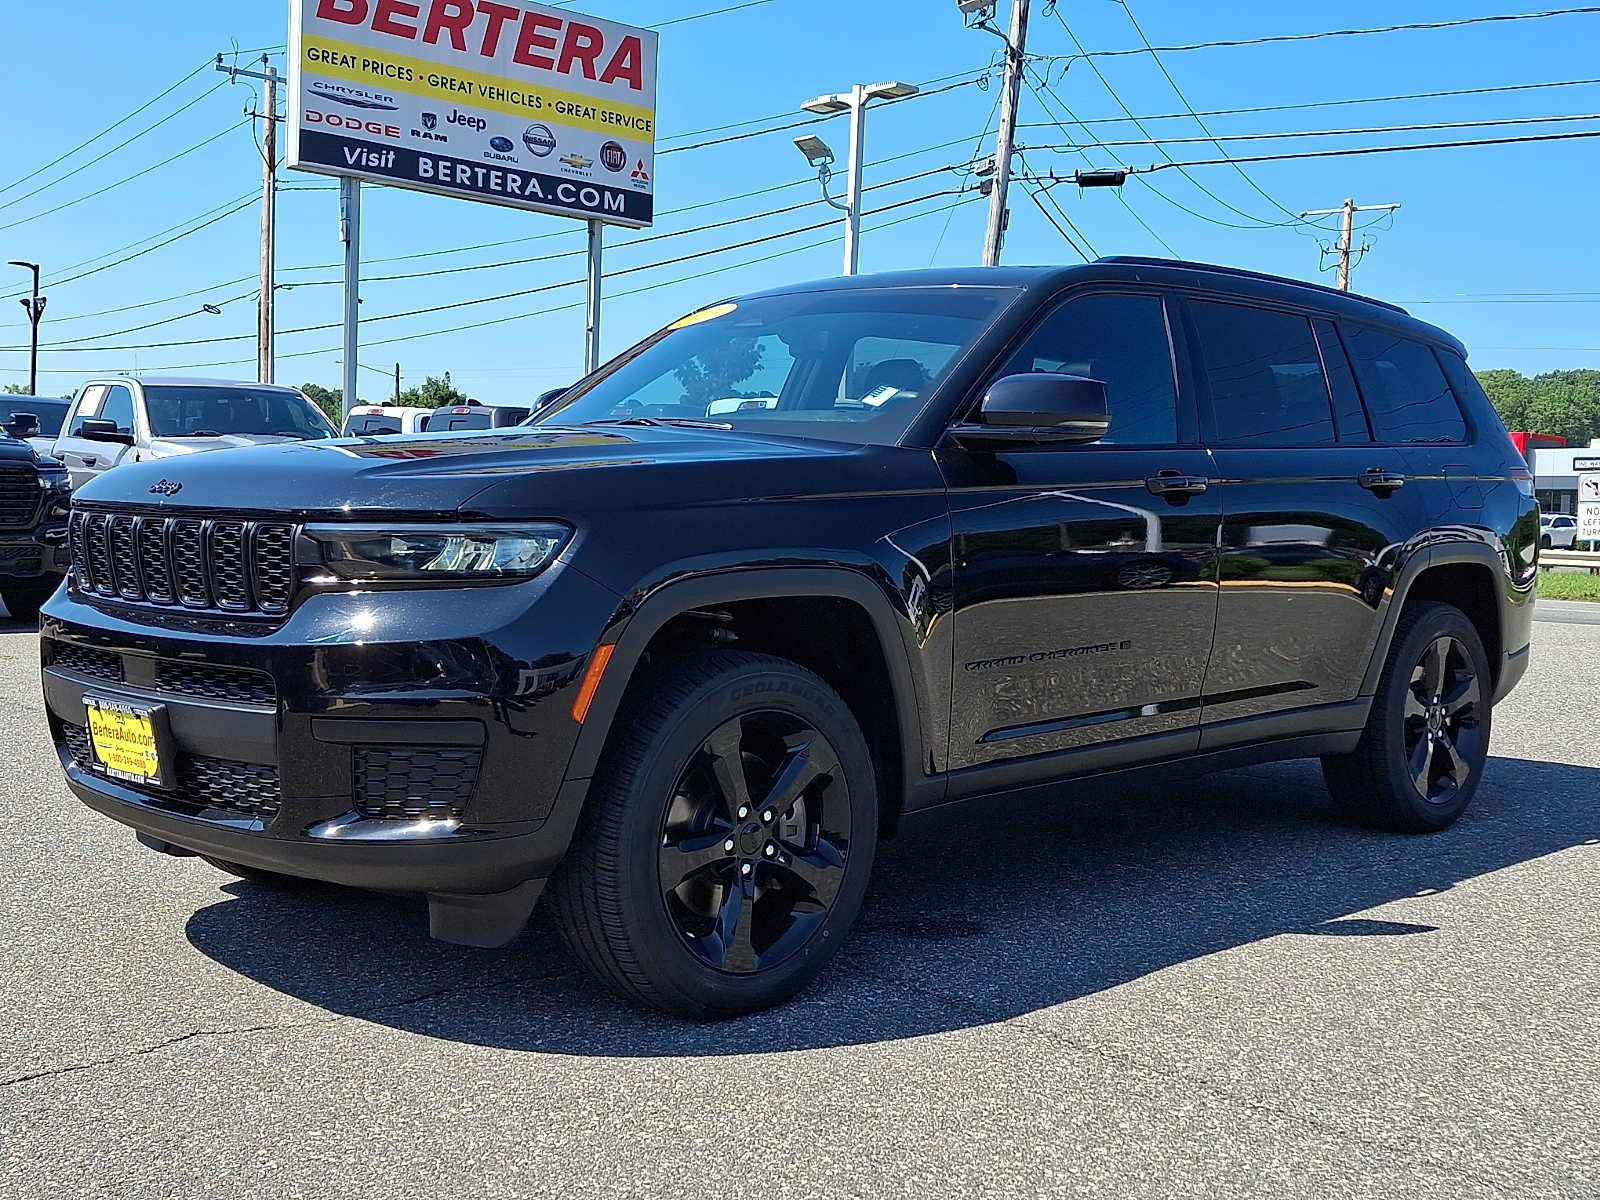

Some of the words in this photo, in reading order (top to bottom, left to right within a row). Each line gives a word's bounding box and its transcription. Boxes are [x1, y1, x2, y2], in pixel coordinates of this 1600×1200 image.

[307, 48, 357, 69] GREAT
[362, 59, 414, 82] PRICES
[312, 81, 394, 103] CHRYSLER
[427, 74, 474, 95] GREAT
[478, 83, 543, 109] VEHICLES
[305, 109, 401, 138] DODGE
[446, 109, 487, 132] Jeep
[555, 100, 597, 121] GREAT
[600, 110, 652, 132] SERVICE
[410, 129, 448, 143] RAM
[526, 135, 553, 147] NISSAN
[483, 151, 519, 163] SUBARU
[605, 147, 622, 165] FIAT
[343, 146, 396, 168] Visit
[418, 156, 626, 213] BERTERA.COM
[1586, 507, 1600, 516] NO
